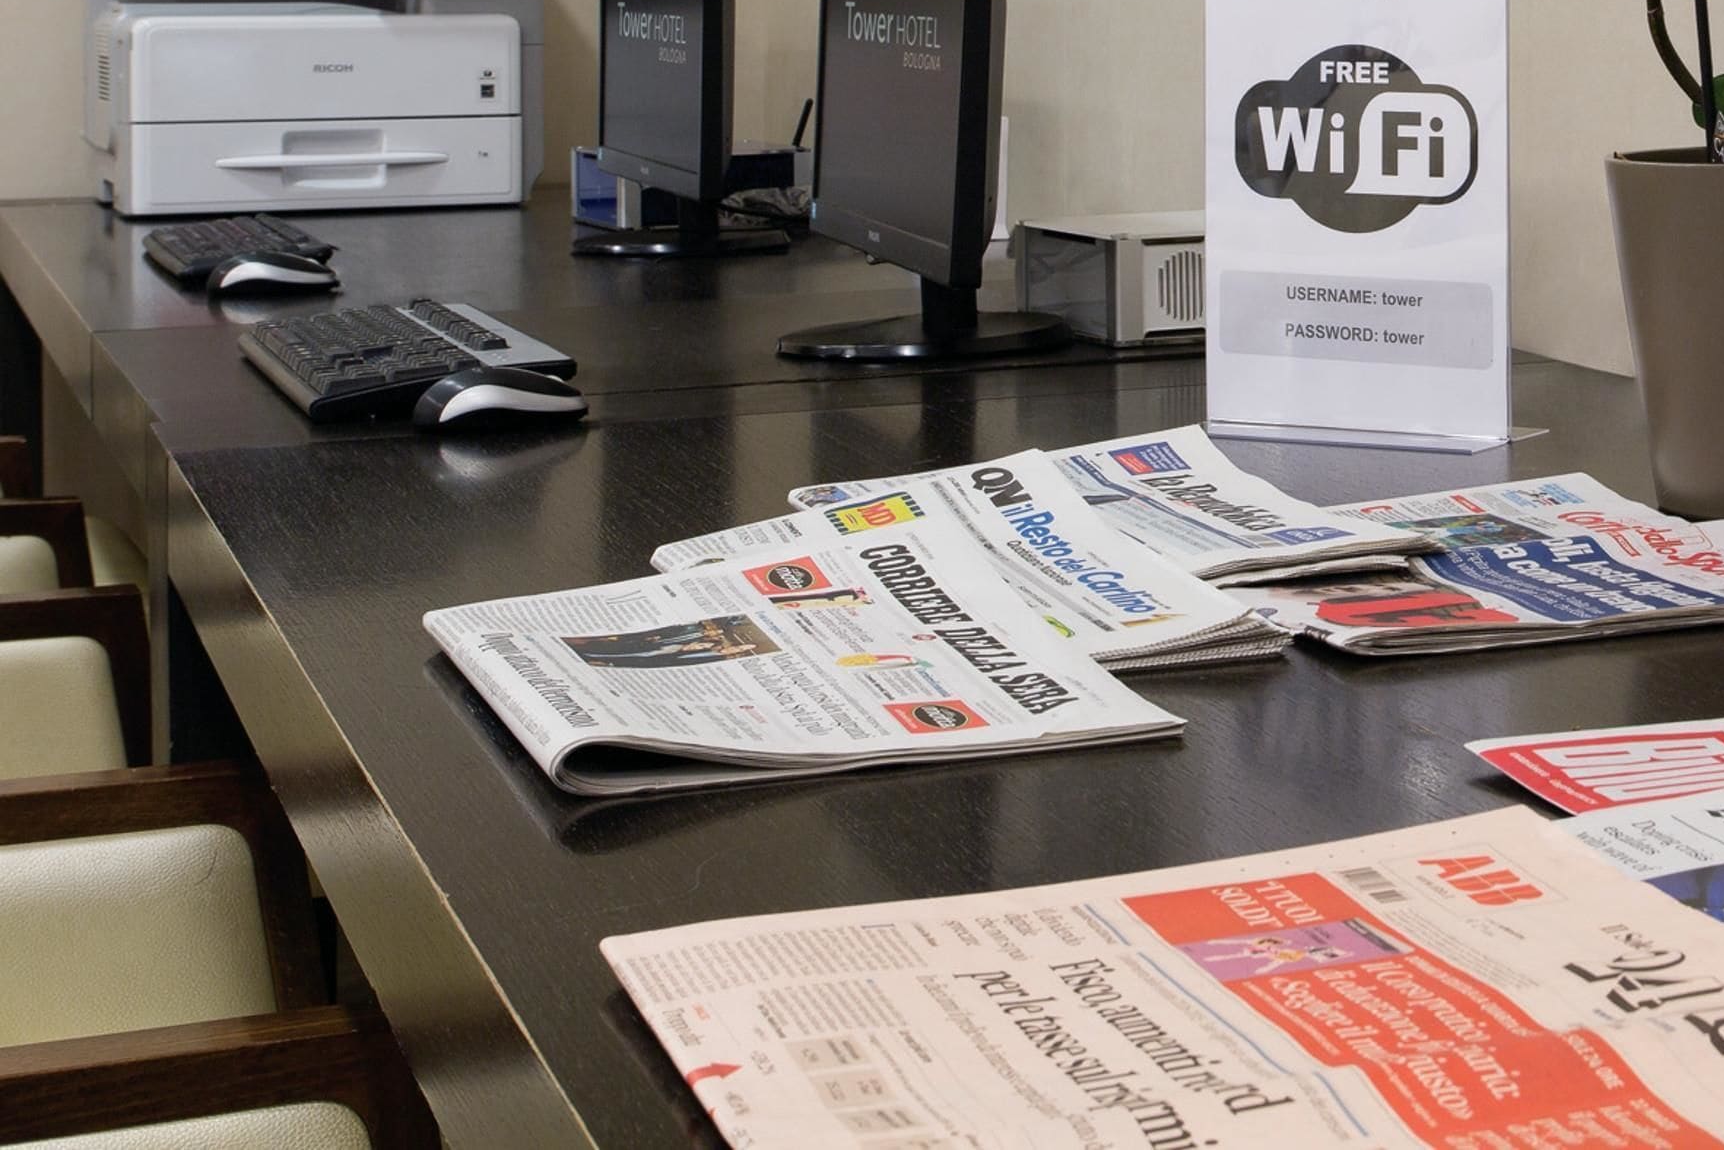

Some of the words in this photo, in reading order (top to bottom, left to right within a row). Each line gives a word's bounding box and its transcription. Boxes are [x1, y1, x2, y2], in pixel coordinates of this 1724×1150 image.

[617, 1, 652, 40] Tower
[654, 14, 686, 44] HOTEL
[845, 1, 894, 44] Tower
[896, 15, 941, 48] HOTEL
[313, 64, 353, 73] RICOH
[903, 51, 941, 70] BOLOGNA
[1320, 60, 1389, 84] FREE
[1286, 286, 1378, 306] USERNAME:
[1381, 291, 1423, 307] tower
[1285, 323, 1379, 343] PASSWORD:
[1383, 329, 1425, 346] tower
[971, 467, 1032, 508] QN
[1001, 503, 1033, 523] il
[1010, 511, 1073, 558] Resto
[1054, 556, 1093, 576] del
[1077, 571, 1156, 614] Carlino
[859, 544, 974, 625] CORRIERE
[933, 626, 1025, 678] DELLA
[1000, 665, 1079, 715] SERA
[1417, 855, 1544, 906] ABB
[952, 970, 1030, 998] per
[999, 997, 1056, 1022] le
[1050, 958, 1122, 1007] Fisco,
[1098, 1003, 1222, 1075] aumenti
[1015, 1016, 1087, 1059] tasse
[1056, 1055, 1138, 1093] sul
